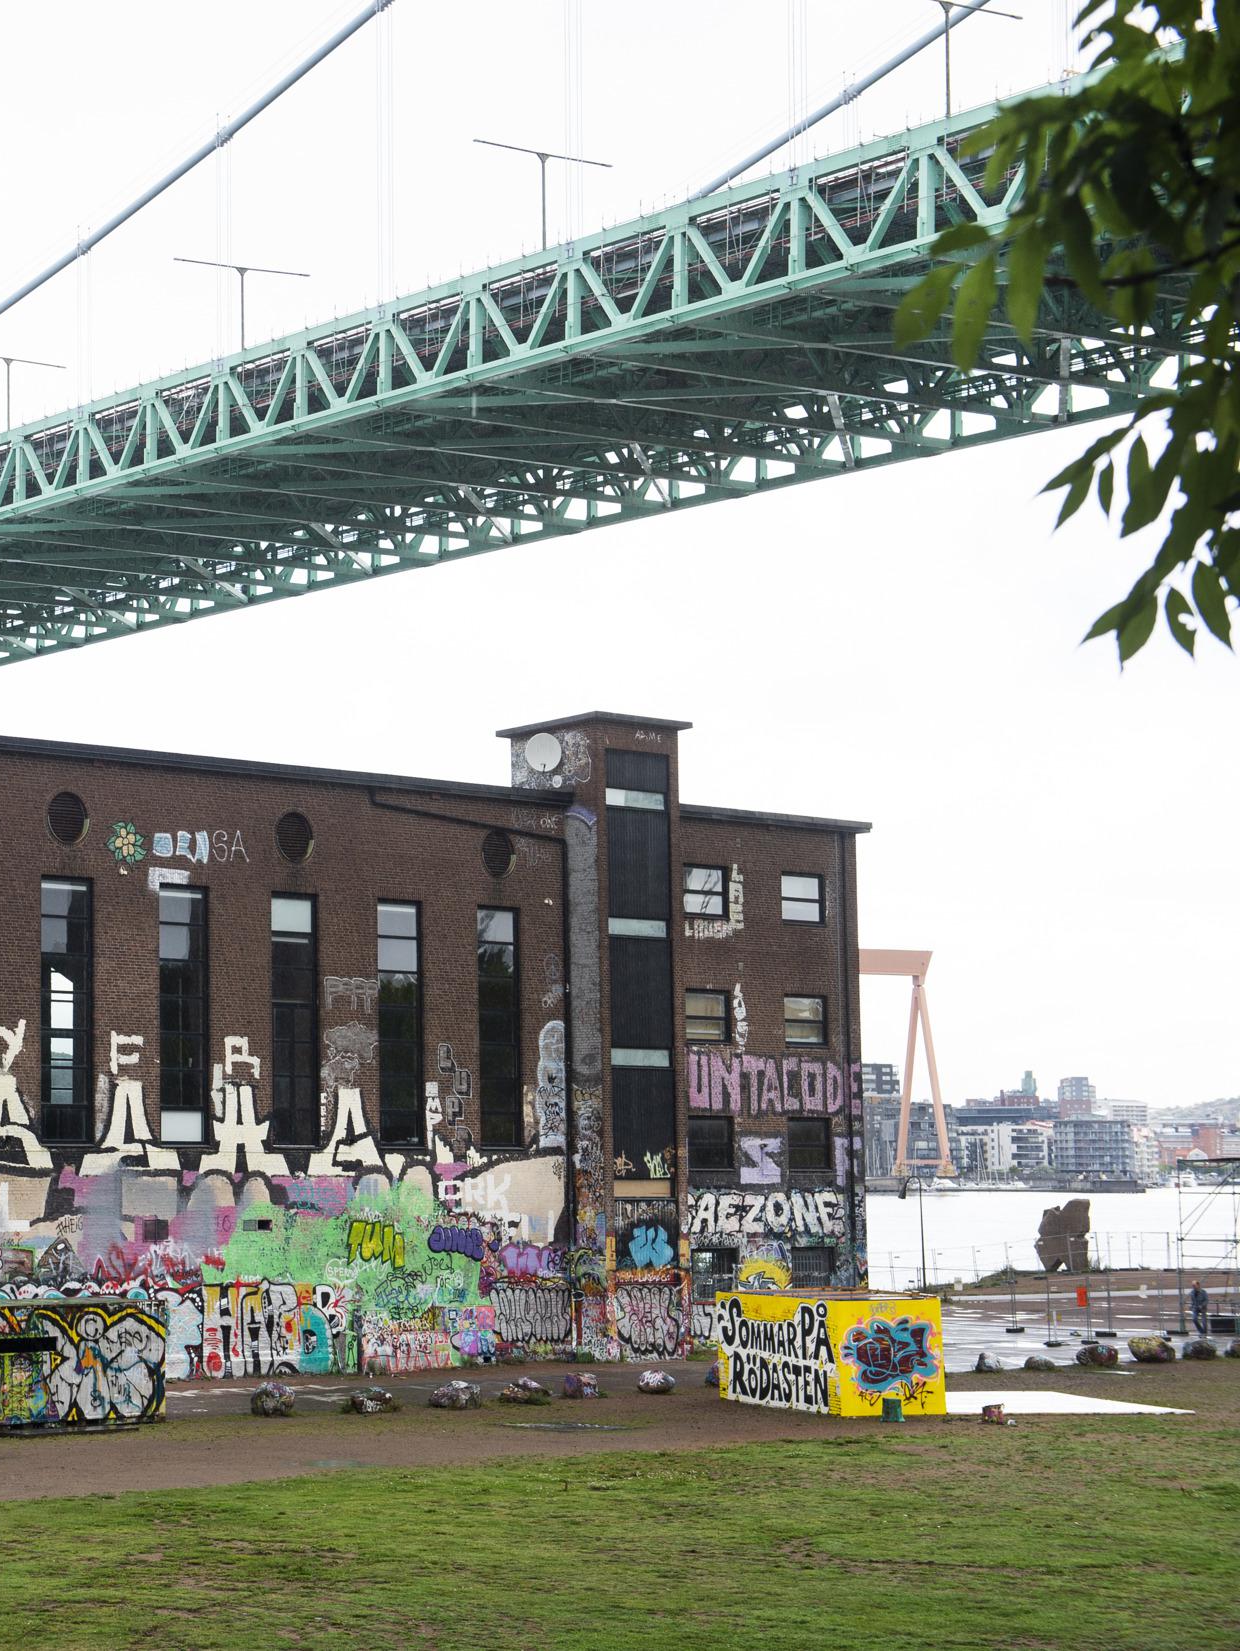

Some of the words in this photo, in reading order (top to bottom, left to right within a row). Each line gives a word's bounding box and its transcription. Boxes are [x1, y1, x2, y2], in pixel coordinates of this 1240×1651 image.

[721, 1296, 797, 1360] SOMMAR
[799, 1302, 835, 1365] PÅ
[731, 1350, 829, 1407] RÖDASTEN
